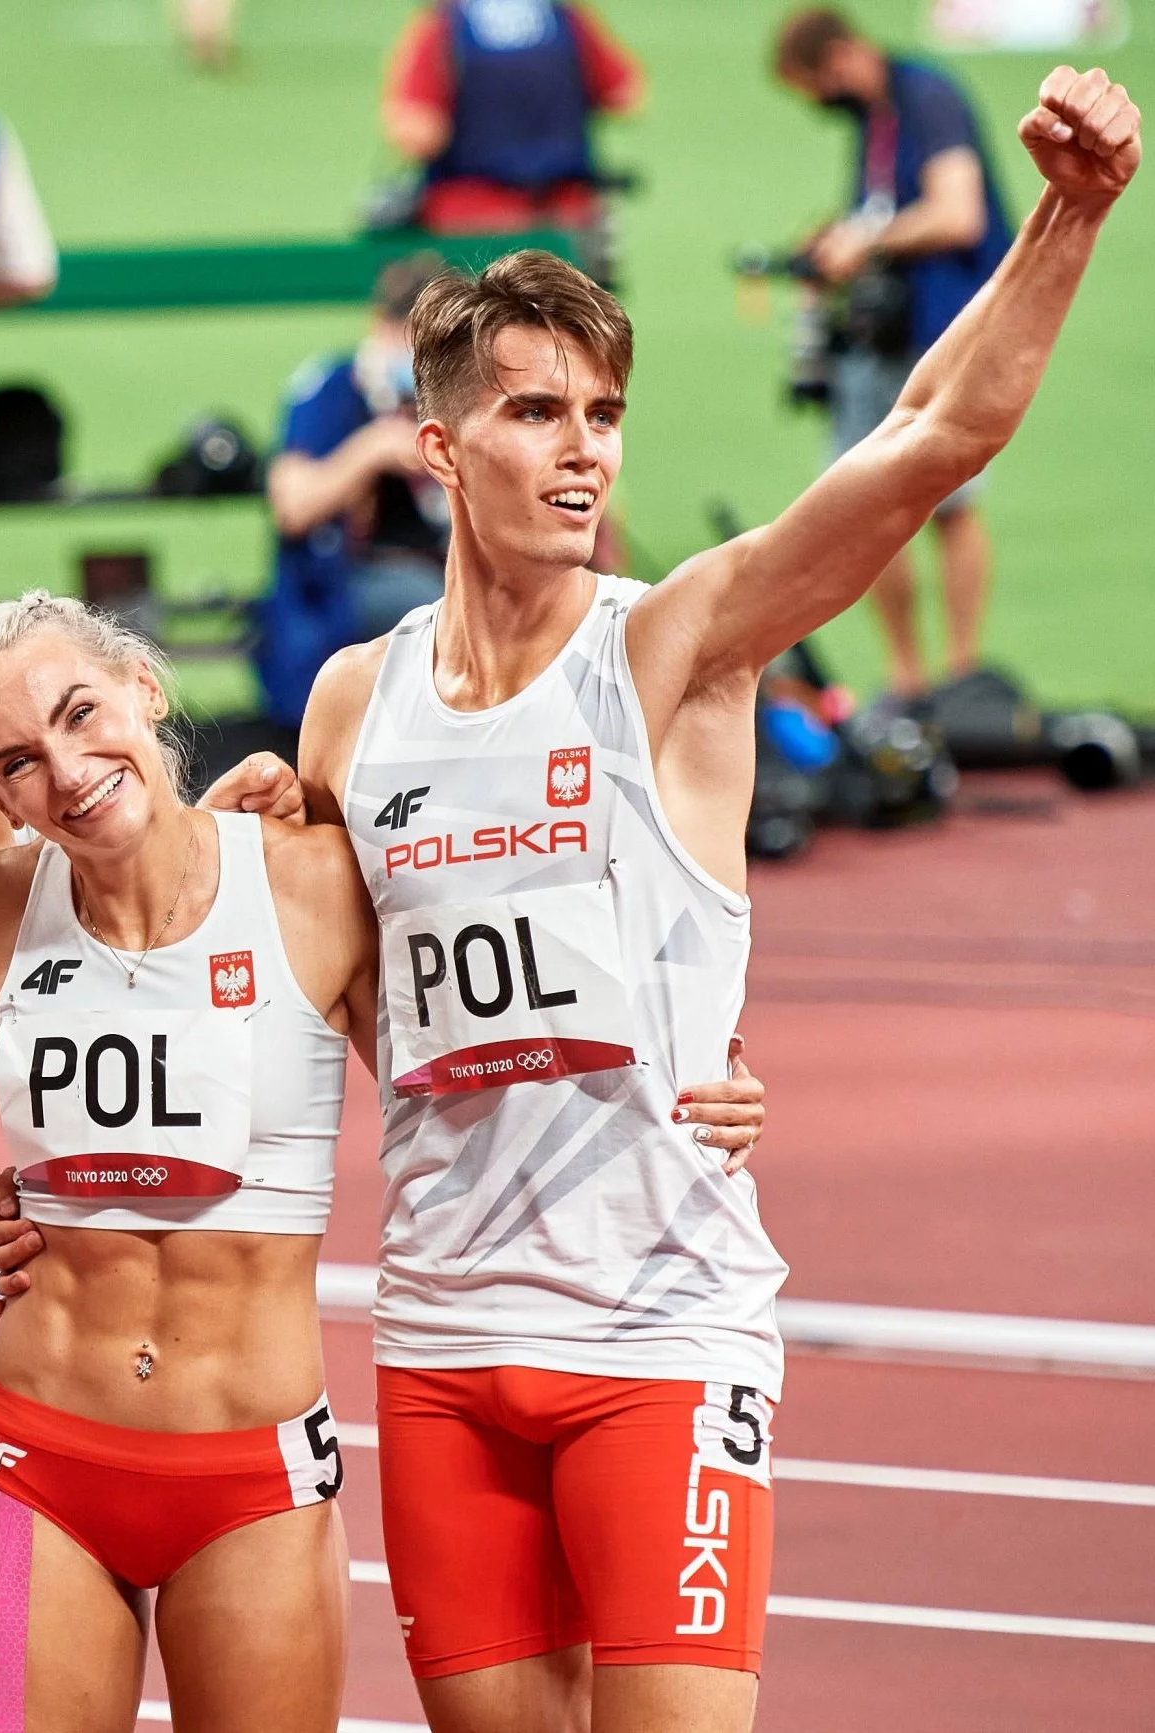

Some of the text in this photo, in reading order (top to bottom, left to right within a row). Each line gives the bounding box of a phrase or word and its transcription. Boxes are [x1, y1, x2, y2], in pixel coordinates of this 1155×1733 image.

[551, 748, 588, 760] POLSKA
[373, 786, 431, 830] 4F
[385, 821, 587, 879] POLSKA
[21, 959, 82, 995] 4F
[213, 952, 250, 965] POLSKA
[407, 916, 578, 1028] POL
[29, 1034, 201, 1128] POL
[449, 1059, 514, 1079] TOKYO 2020
[65, 1170, 128, 1183] TOKYO 2020
[722, 1384, 761, 1466] 5
[304, 1404, 344, 1502] 5
